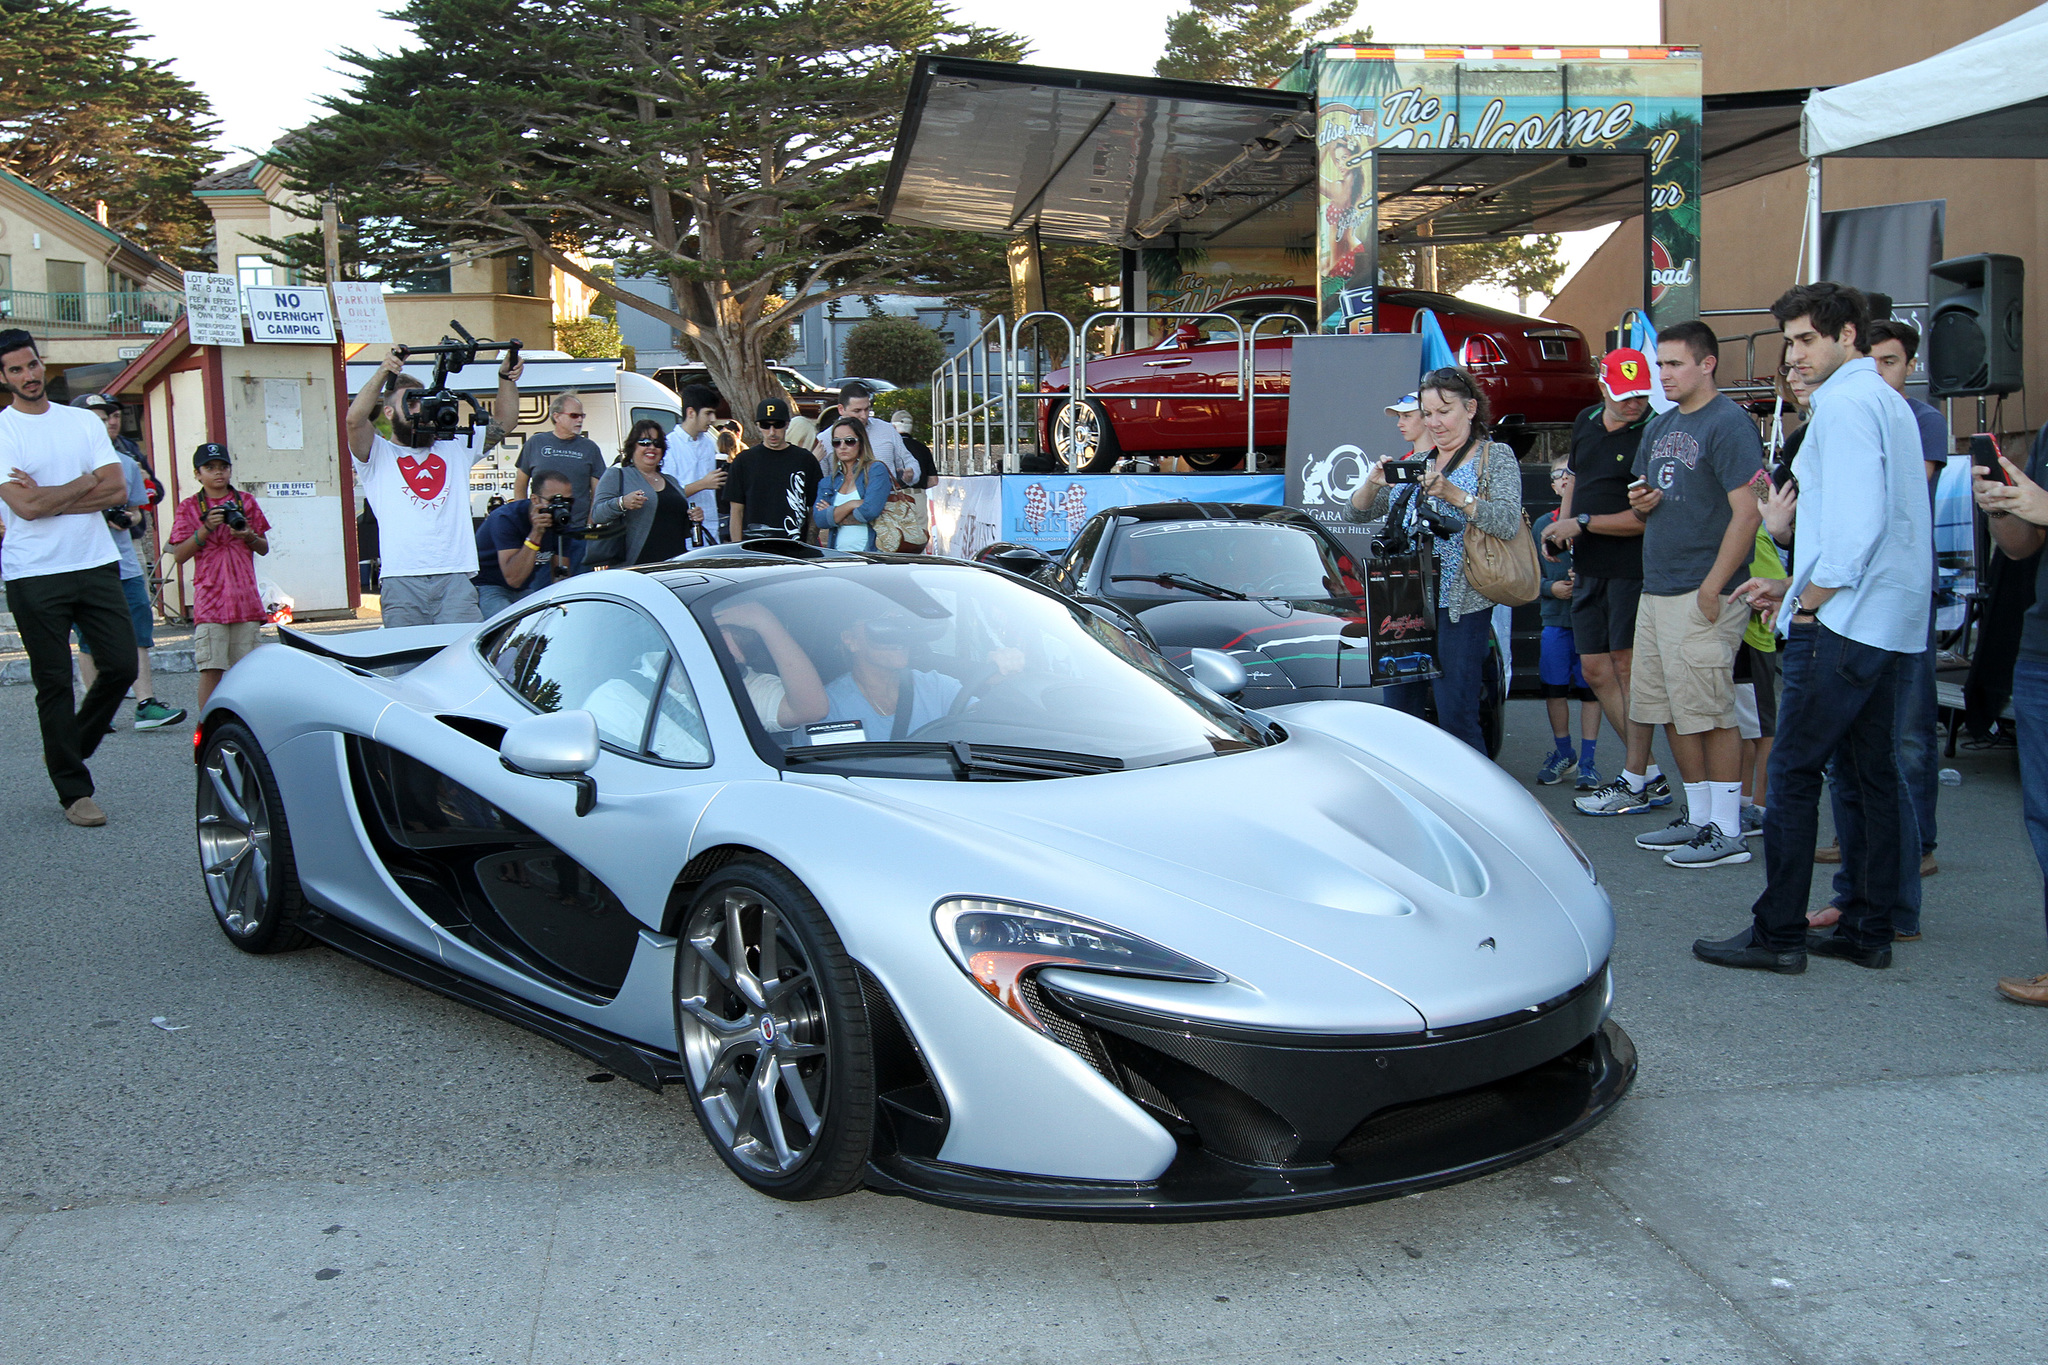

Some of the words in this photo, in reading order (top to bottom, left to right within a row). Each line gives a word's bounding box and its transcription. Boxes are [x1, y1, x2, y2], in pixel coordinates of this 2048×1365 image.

[1383, 86, 1440, 126] The
[1319, 119, 1346, 147] dise
[1652, 260, 1693, 286] oad
[187, 275, 202, 283] LOT
[207, 276, 234, 286] OPENS
[1179, 272, 1204, 290] The
[192, 284, 201, 292] AT
[206, 285, 211, 293] 8
[347, 284, 369, 293] PAY
[213, 298, 236, 306] EFFECT
[274, 293, 301, 309] NO
[337, 295, 384, 305] PARKING
[190, 303, 206, 311] PARK
[349, 308, 376, 317] ONLY
[197, 311, 213, 319] OWN
[257, 311, 324, 322] OVERNIGHT
[267, 325, 320, 335] CAMPING
[766, 405, 776, 417] P
[470, 471, 515, 479] ramoto
[1301, 508, 1342, 521] 'GARA
[1014, 517, 1080, 532] LOGIST
[1163, 520, 1290, 532] PAGANI
[1328, 526, 1347, 534] ERLY
